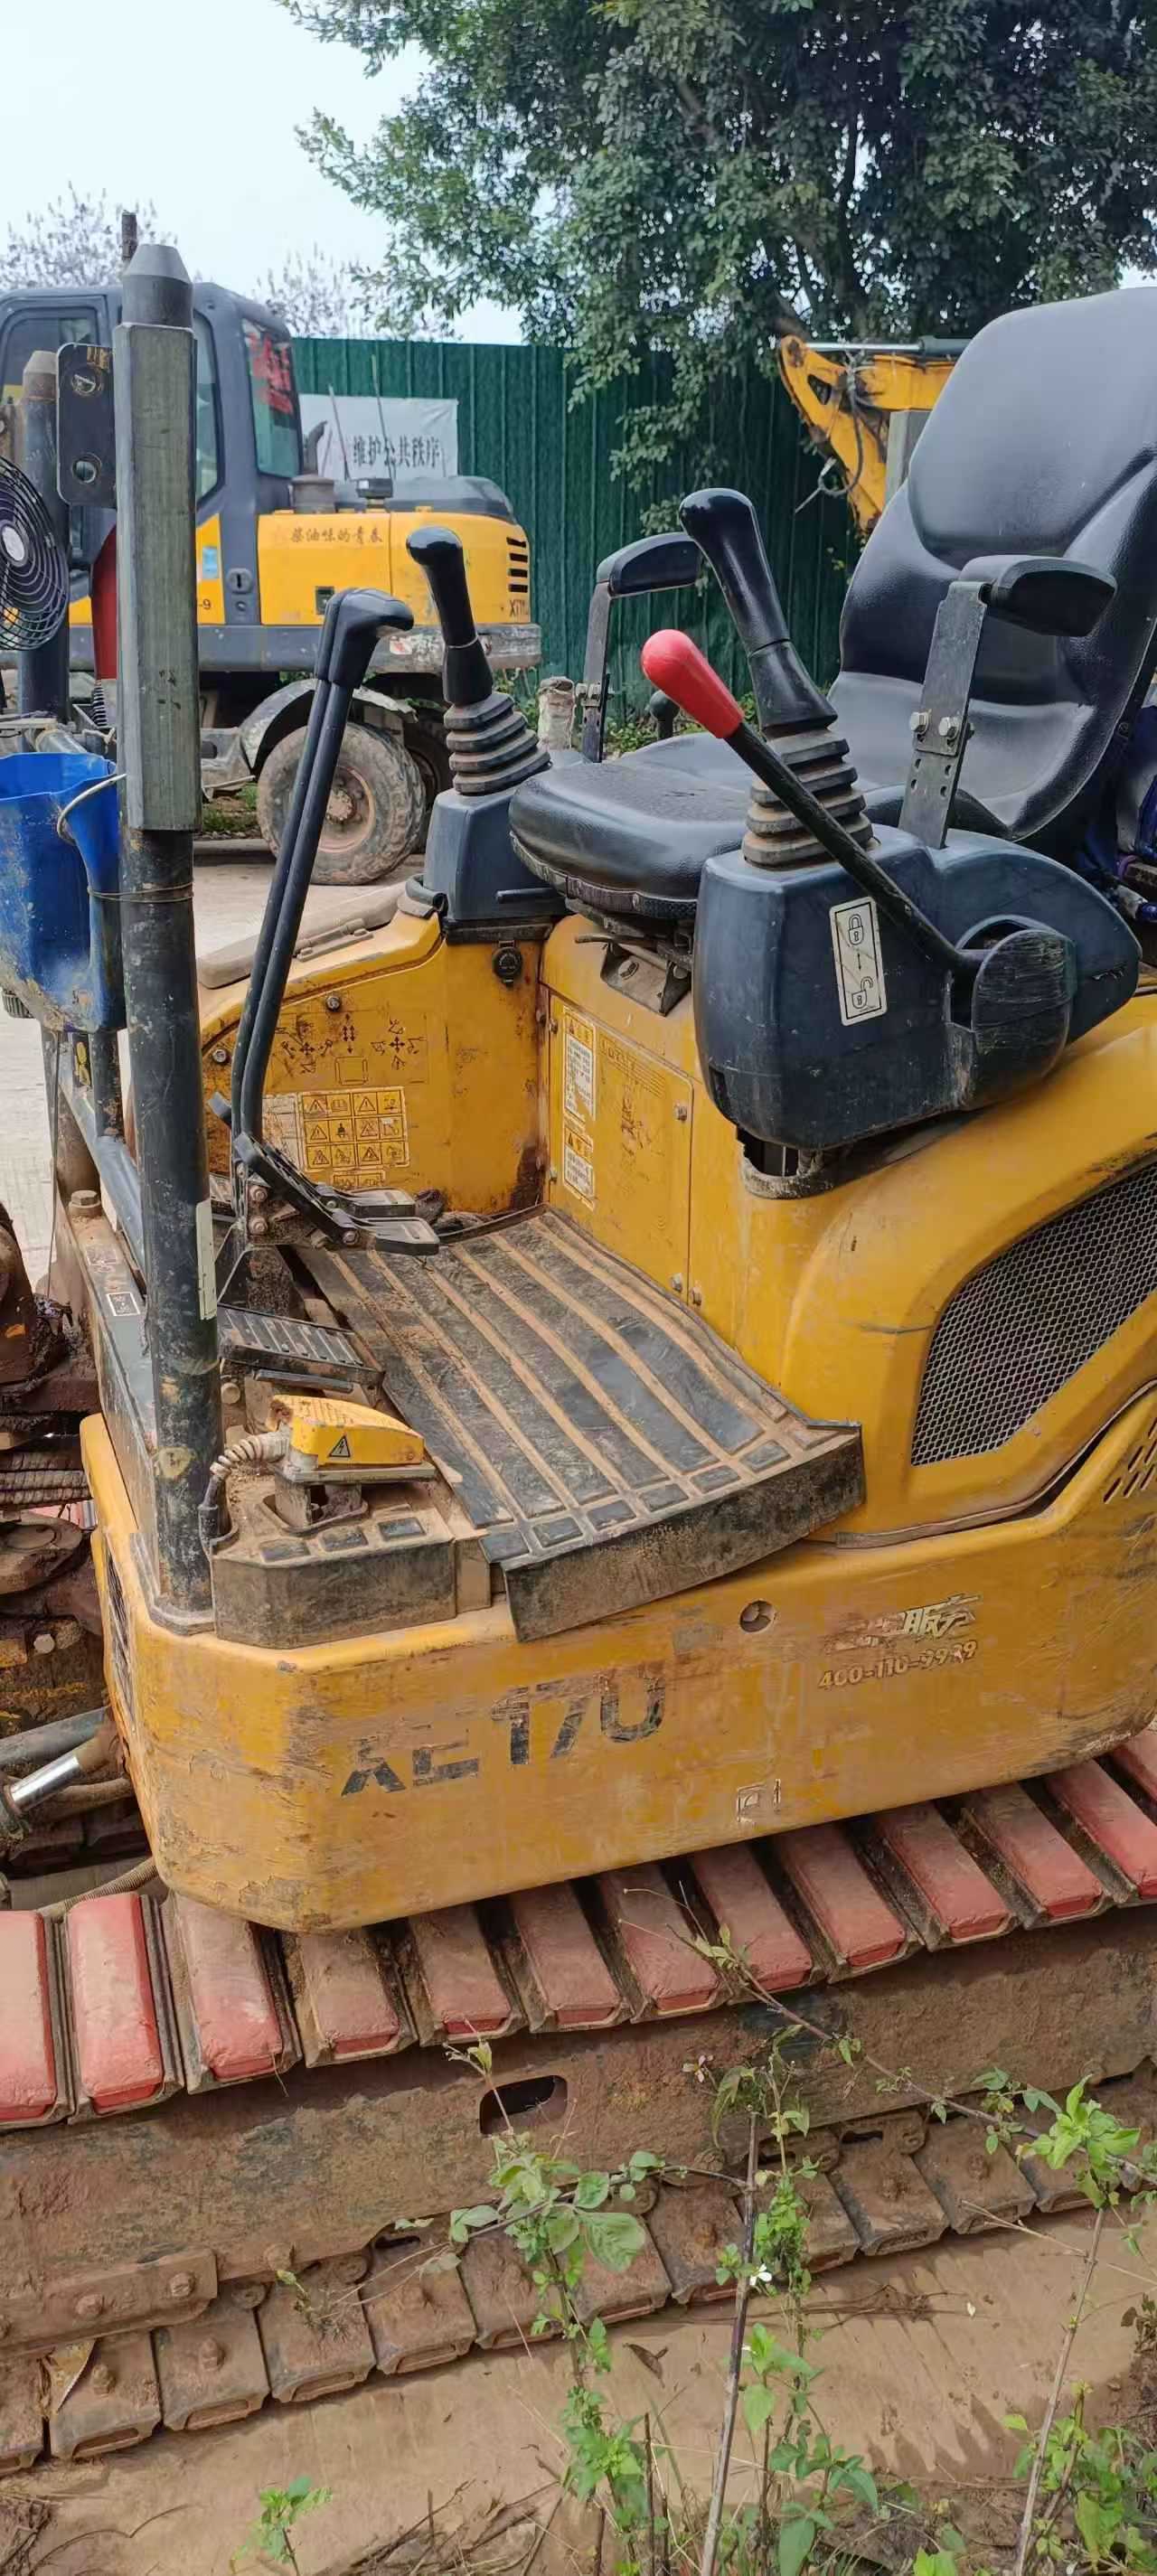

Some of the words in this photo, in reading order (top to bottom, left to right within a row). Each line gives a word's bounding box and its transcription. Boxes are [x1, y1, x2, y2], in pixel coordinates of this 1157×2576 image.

[353, 435, 441, 468] 维护公共秩序
